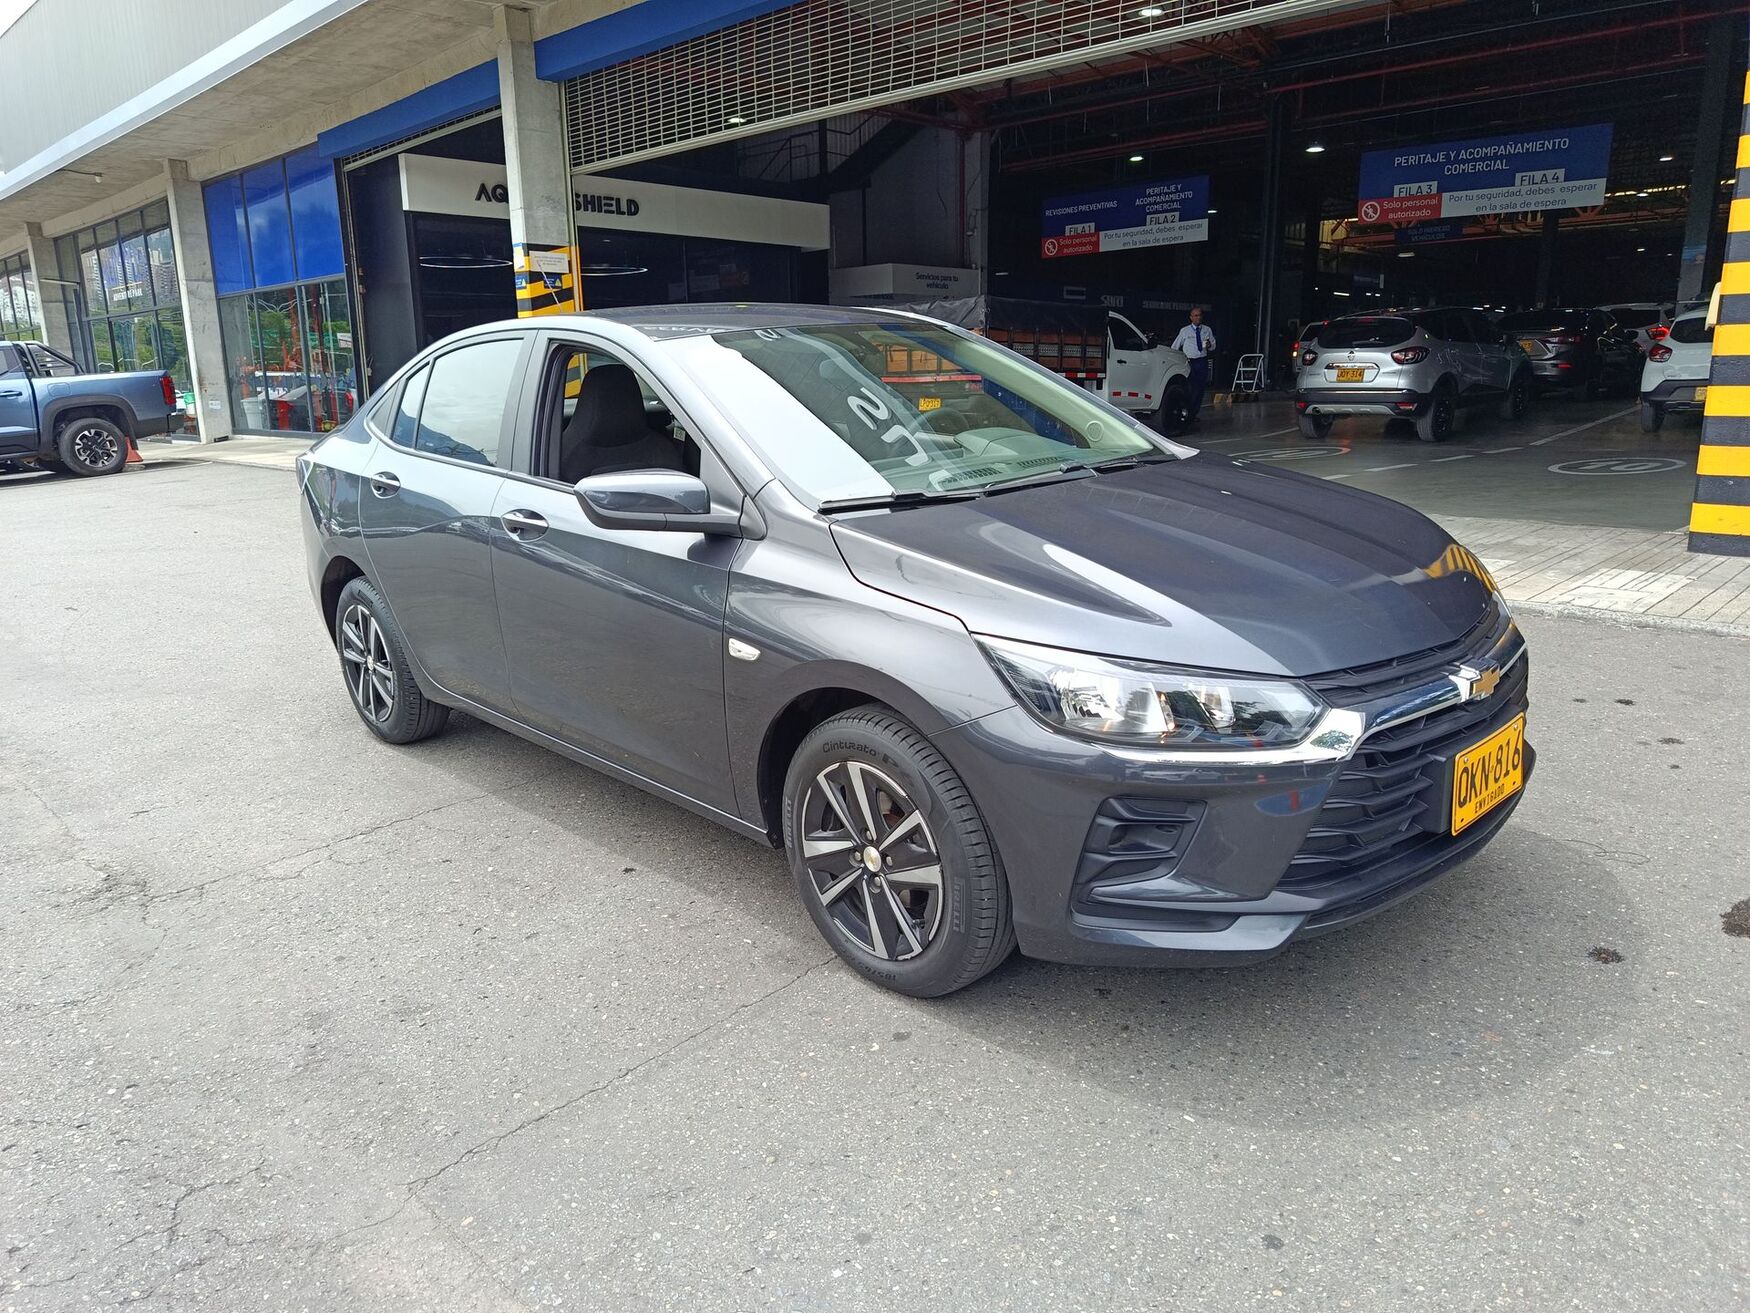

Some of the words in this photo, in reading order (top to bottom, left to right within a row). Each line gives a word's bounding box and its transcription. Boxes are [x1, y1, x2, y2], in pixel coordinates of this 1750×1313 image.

[1394, 151, 1447, 167] PERITAJE
[1449, 150, 1457, 161] Y
[1459, 138, 1569, 160] ACOMPAÑAMIENTO
[1444, 159, 1509, 175] COMERCIAL
[1519, 173, 1550, 186] FILA
[1552, 172, 1560, 183] 4
[1146, 184, 1175, 196] PERITAJE
[1176, 184, 1182, 192] Y
[1398, 185, 1424, 197] FILA
[1426, 184, 1433, 195] 3
[1448, 193, 1463, 203] Por
[1465, 192, 1474, 202] tu
[1476, 188, 1524, 202] seguridad,
[1525, 185, 1555, 197] debes
[1560, 182, 1598, 195] esperar
[1135, 191, 1193, 206] ACOMPAÑAMIENTO
[1382, 200, 1401, 210] Solo
[1402, 196, 1438, 210] personal
[1476, 204, 1487, 212] en
[1488, 202, 1496, 212] la
[1498, 200, 1518, 211] sala
[1520, 200, 1532, 208] de
[1534, 198, 1567, 210] espera
[1045, 206, 1078, 217] REVISIONES
[1078, 200, 1118, 213] PREVENTIVAS
[1146, 202, 1182, 213] COMERCIAL
[1388, 208, 1432, 220] autorizado
[1150, 216, 1169, 226] FILA
[1170, 214, 1176, 224] 2
[1069, 226, 1087, 236] FILA
[822, 740, 877, 757] Cinturato
[1474, 783, 1505, 814] ENVIGADO
